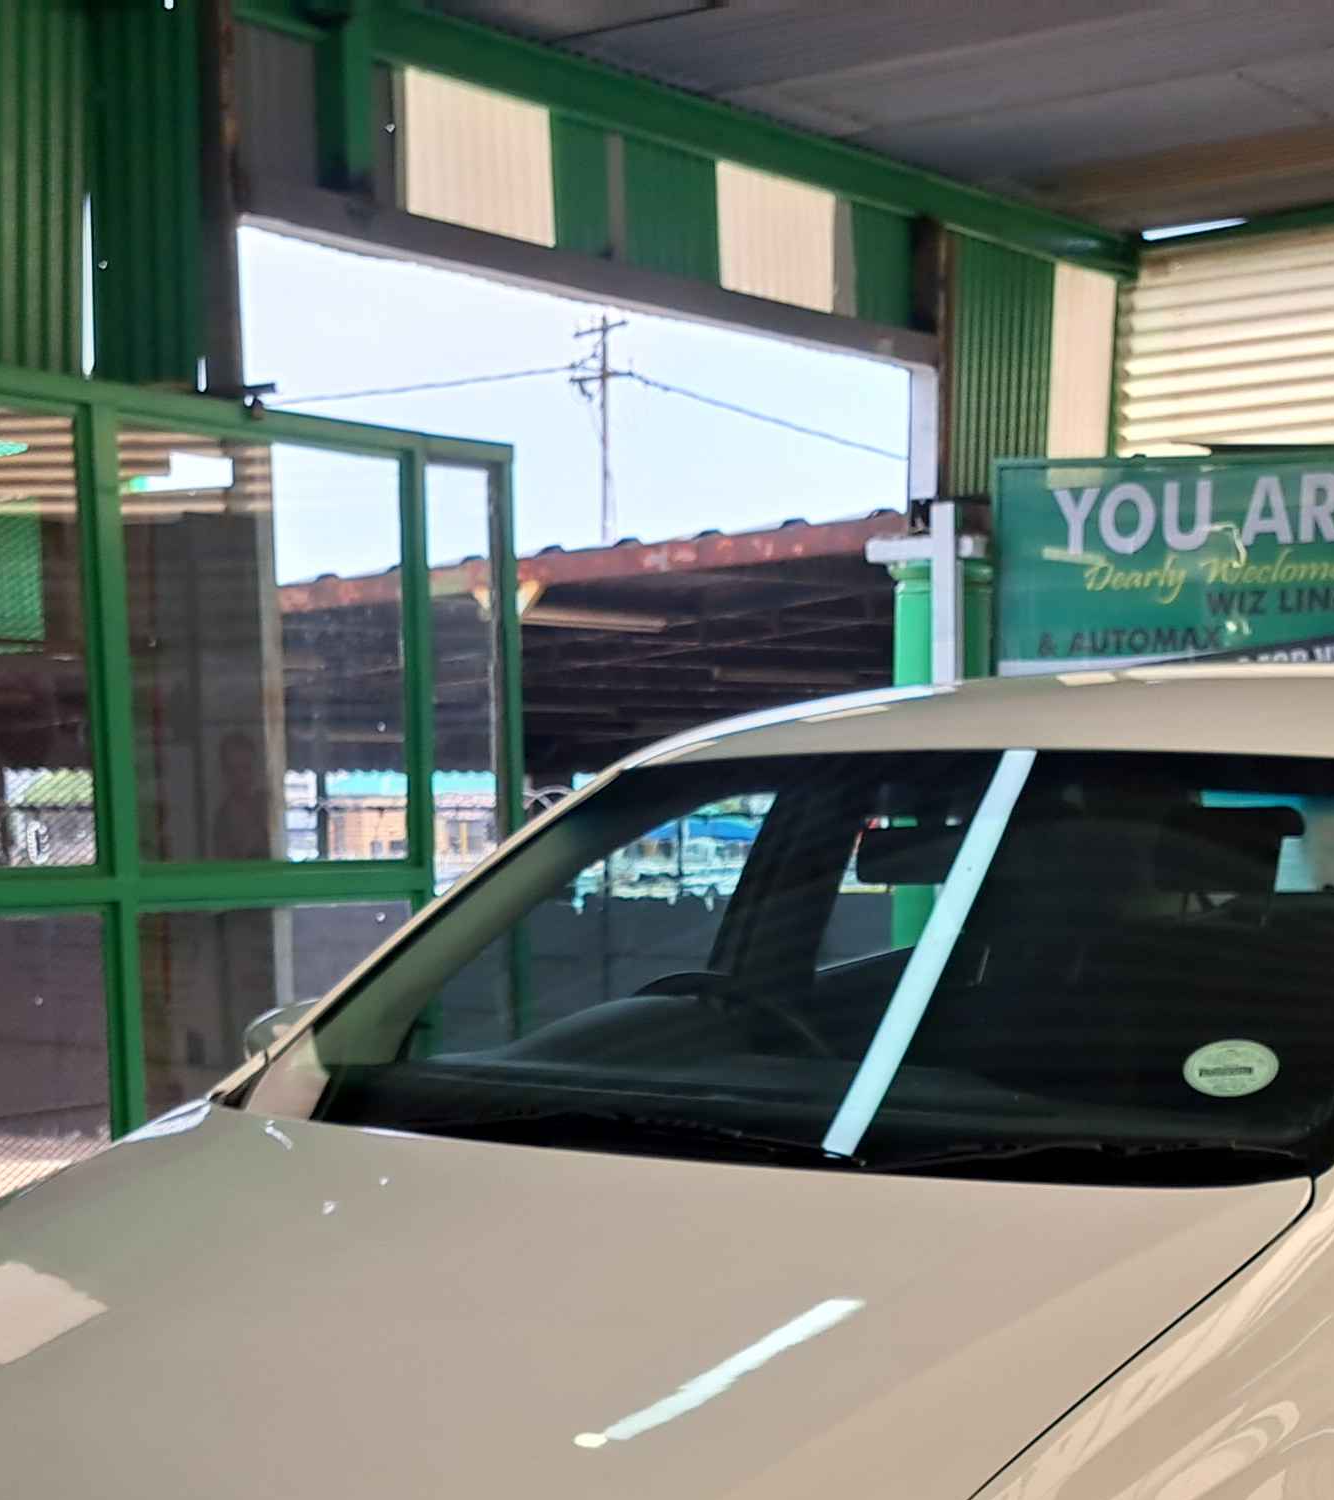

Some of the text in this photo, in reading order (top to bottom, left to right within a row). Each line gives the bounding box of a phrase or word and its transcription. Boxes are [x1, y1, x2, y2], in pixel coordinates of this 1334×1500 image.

[1052, 480, 1213, 556] YOU
[1084, 556, 1188, 603] Dearly
[1206, 588, 1267, 616] WIZ
[1068, 626, 1225, 655] AUTOMAX
